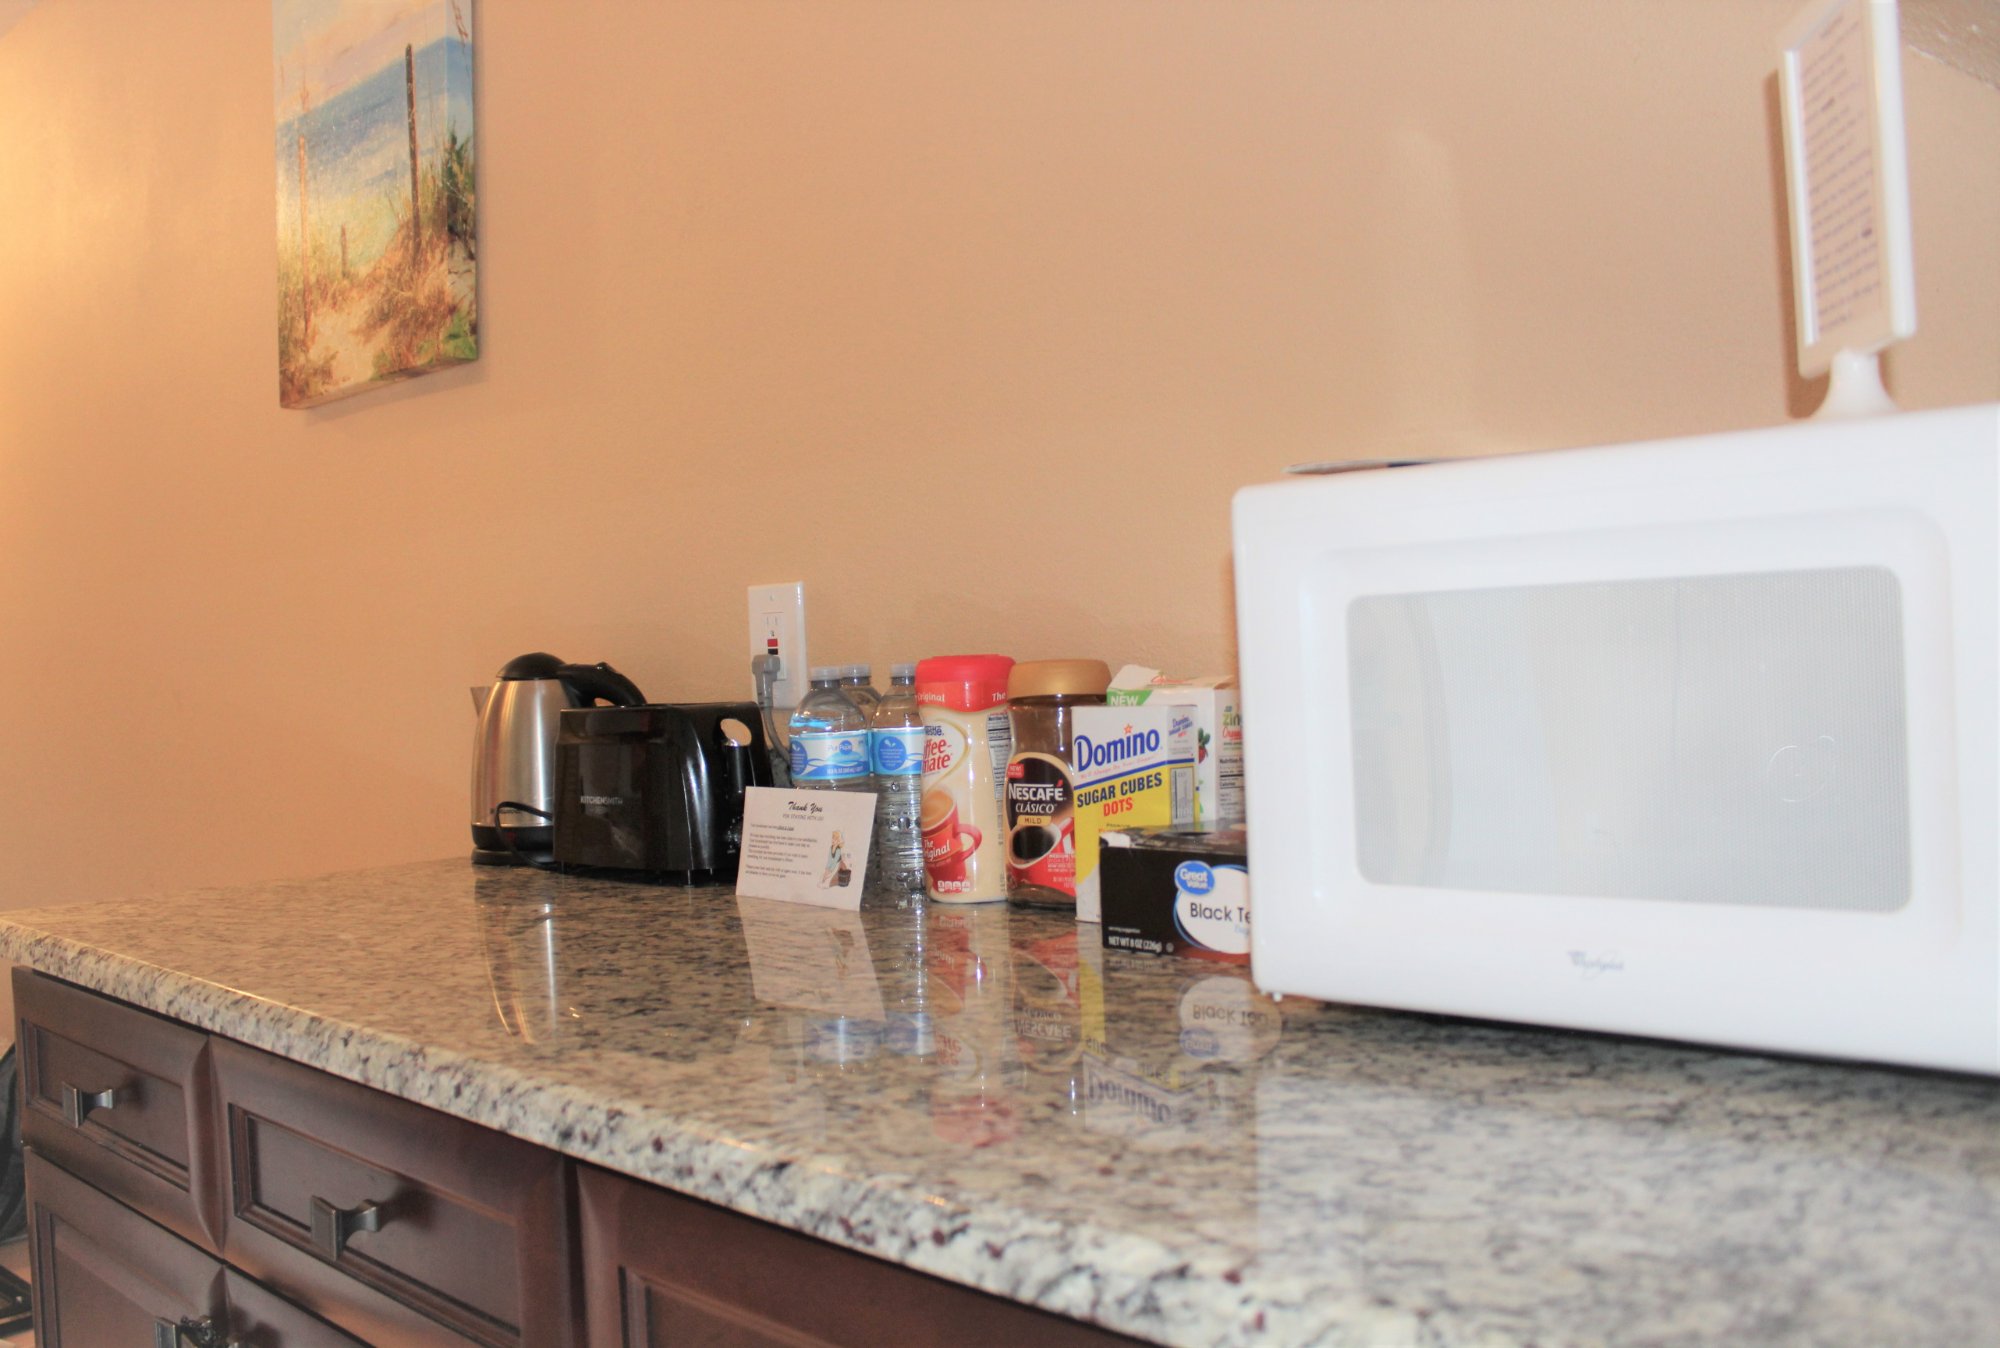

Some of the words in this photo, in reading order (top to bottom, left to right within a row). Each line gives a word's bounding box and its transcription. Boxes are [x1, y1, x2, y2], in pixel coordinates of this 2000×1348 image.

[992, 692, 1006, 702] The
[1110, 695, 1139, 706] NEW
[1223, 713, 1241, 727] zin
[1074, 729, 1160, 772] Domino
[1008, 779, 1064, 801] NESCAFÉ
[1077, 785, 1116, 808] SUGAR
[1120, 772, 1163, 796] CUBES
[788, 801, 808, 813] Thank
[810, 802, 823, 814] You
[1015, 801, 1056, 814] CLÁSICO
[1103, 797, 1133, 817] DOTS
[1025, 817, 1042, 825] MILD
[924, 839, 934, 848] The
[924, 840, 951, 861] riginal
[1180, 868, 1208, 883] Great
[1186, 879, 1209, 890] Value
[1190, 902, 1232, 922] Black
[1237, 907, 1250, 924] Te
[1108, 935, 1120, 946] NET
[1120, 936, 1130, 947] WT
[1135, 938, 1143, 949] OZ
